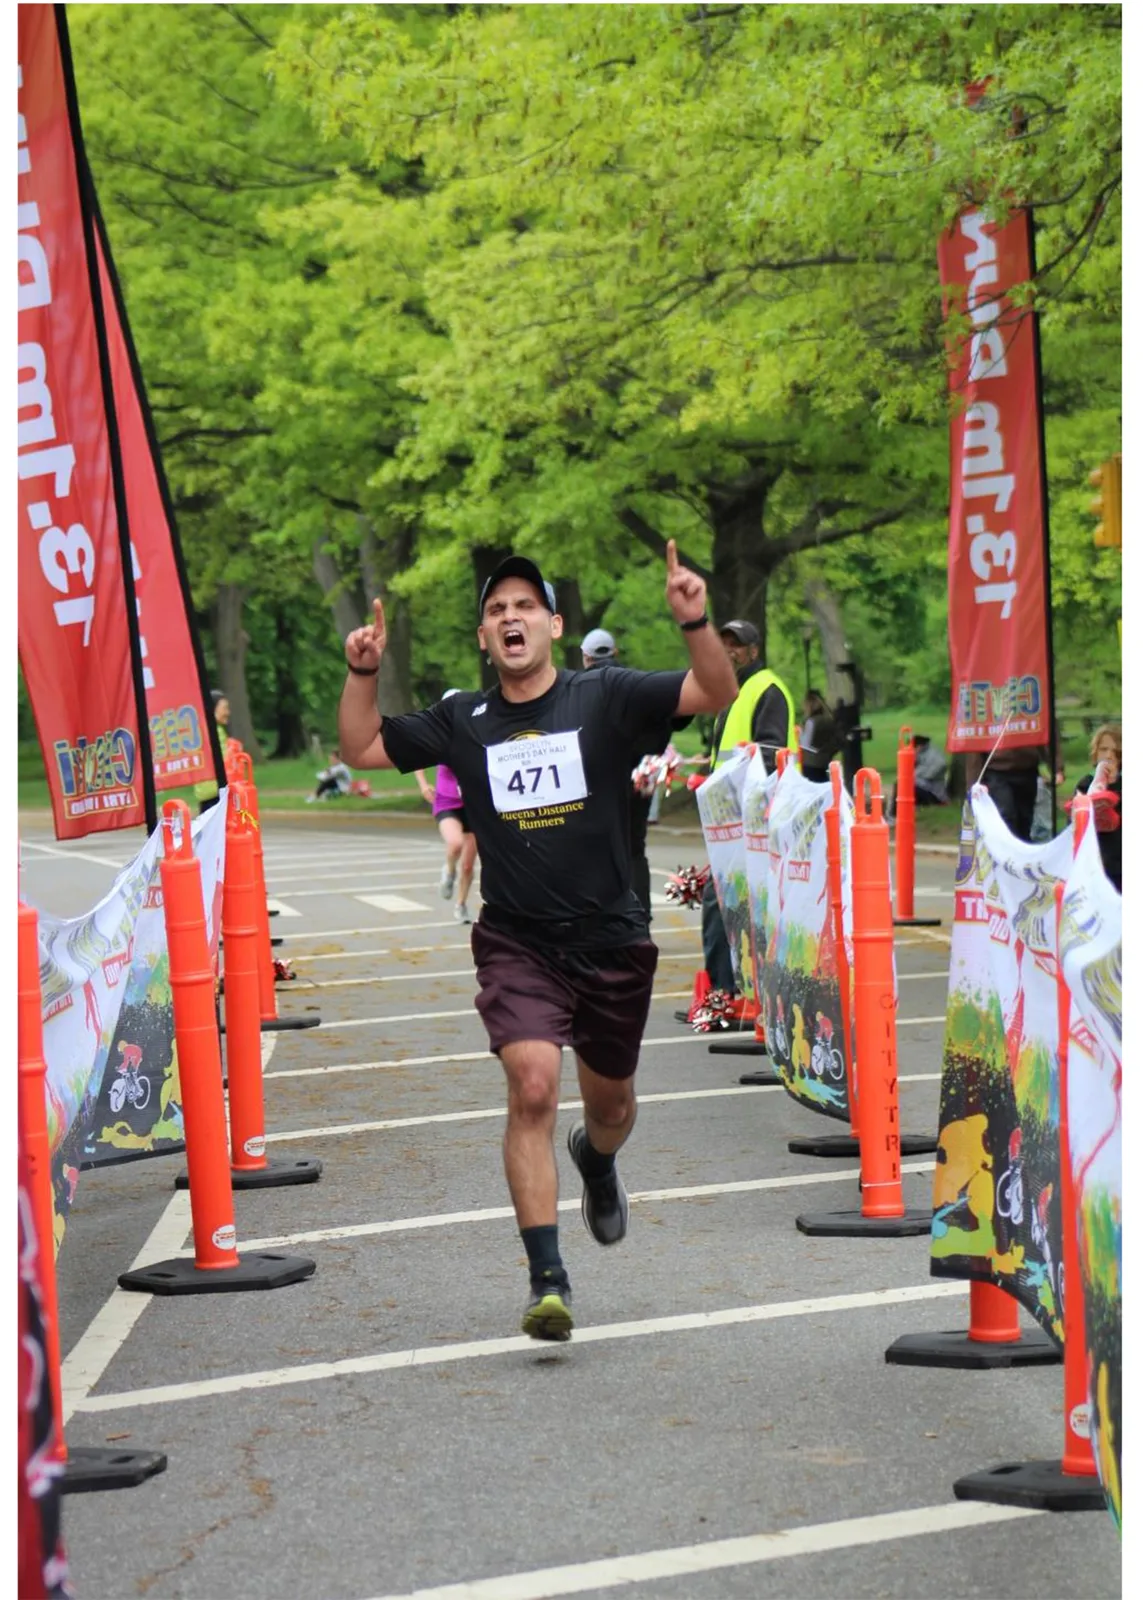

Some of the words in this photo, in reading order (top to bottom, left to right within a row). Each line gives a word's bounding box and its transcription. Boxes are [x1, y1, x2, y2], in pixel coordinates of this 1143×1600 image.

[532, 747, 547, 757] DAY
[507, 764, 561, 795] 471
[502, 809, 536, 820] ueens
[539, 801, 584, 816] Distance
[519, 816, 565, 830] Runners
